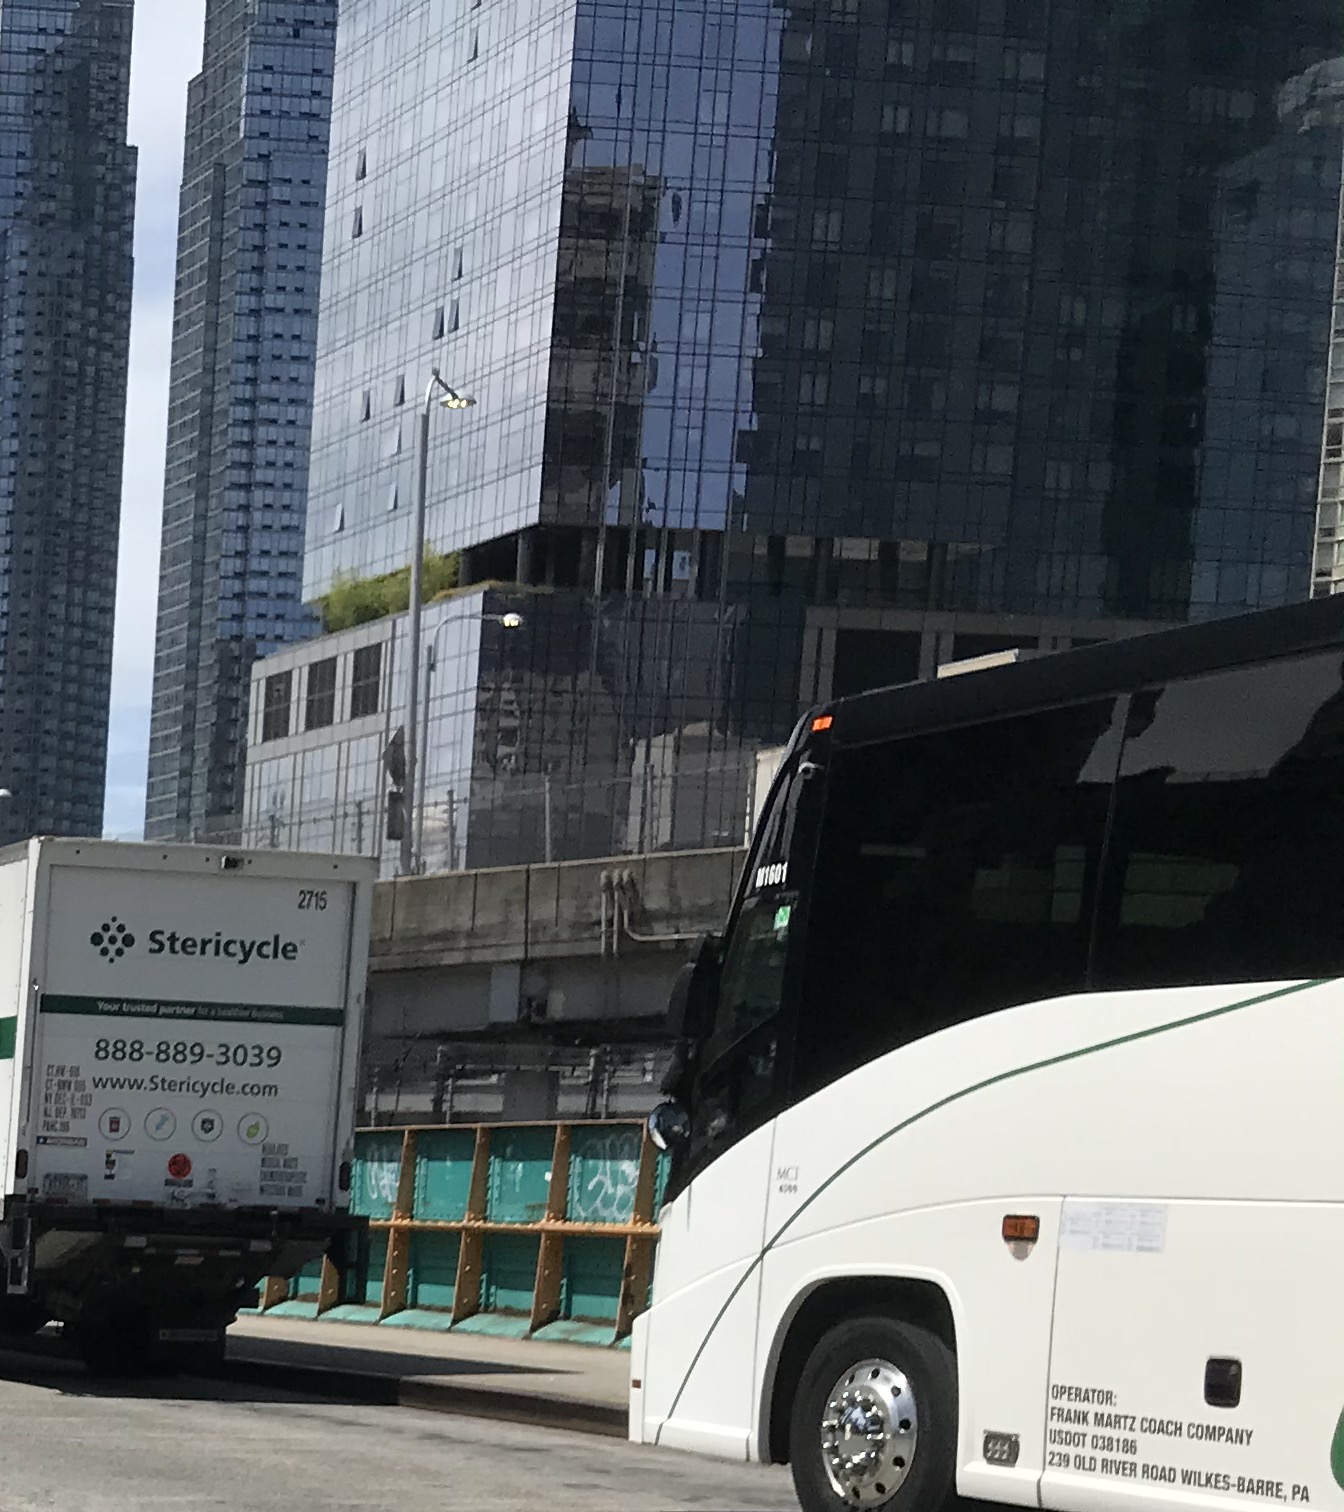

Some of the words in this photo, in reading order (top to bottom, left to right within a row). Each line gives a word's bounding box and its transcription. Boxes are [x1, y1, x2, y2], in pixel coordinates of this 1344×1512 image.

[755, 861, 789, 888] M1601
[298, 889, 327, 911] 2715
[148, 929, 298, 965] Stericycle
[97, 1001, 123, 1012] Your
[122, 1003, 157, 1014] trusted
[158, 1005, 196, 1017] partner
[93, 1036, 283, 1068] 888-889-3039
[91, 1074, 279, 1098] www.Stericycle.com
[1051, 1384, 1118, 1407] OPERATOR:
[1050, 1406, 1090, 1426] FRANK
[1093, 1411, 1137, 1433] MARTZ
[1140, 1416, 1183, 1438] COACH
[1186, 1422, 1254, 1446] COMPANY
[1049, 1429, 1088, 1449] USDOT
[1091, 1435, 1138, 1456] 038186
[1048, 1451, 1071, 1469] 239
[1073, 1454, 1098, 1473] OLD
[1101, 1457, 1138, 1479] RIVER
[1141, 1463, 1178, 1484] ROAD
[1180, 1468, 1288, 1503] WILKES-BARRE,
[1291, 1483, 1311, 1503] PA
